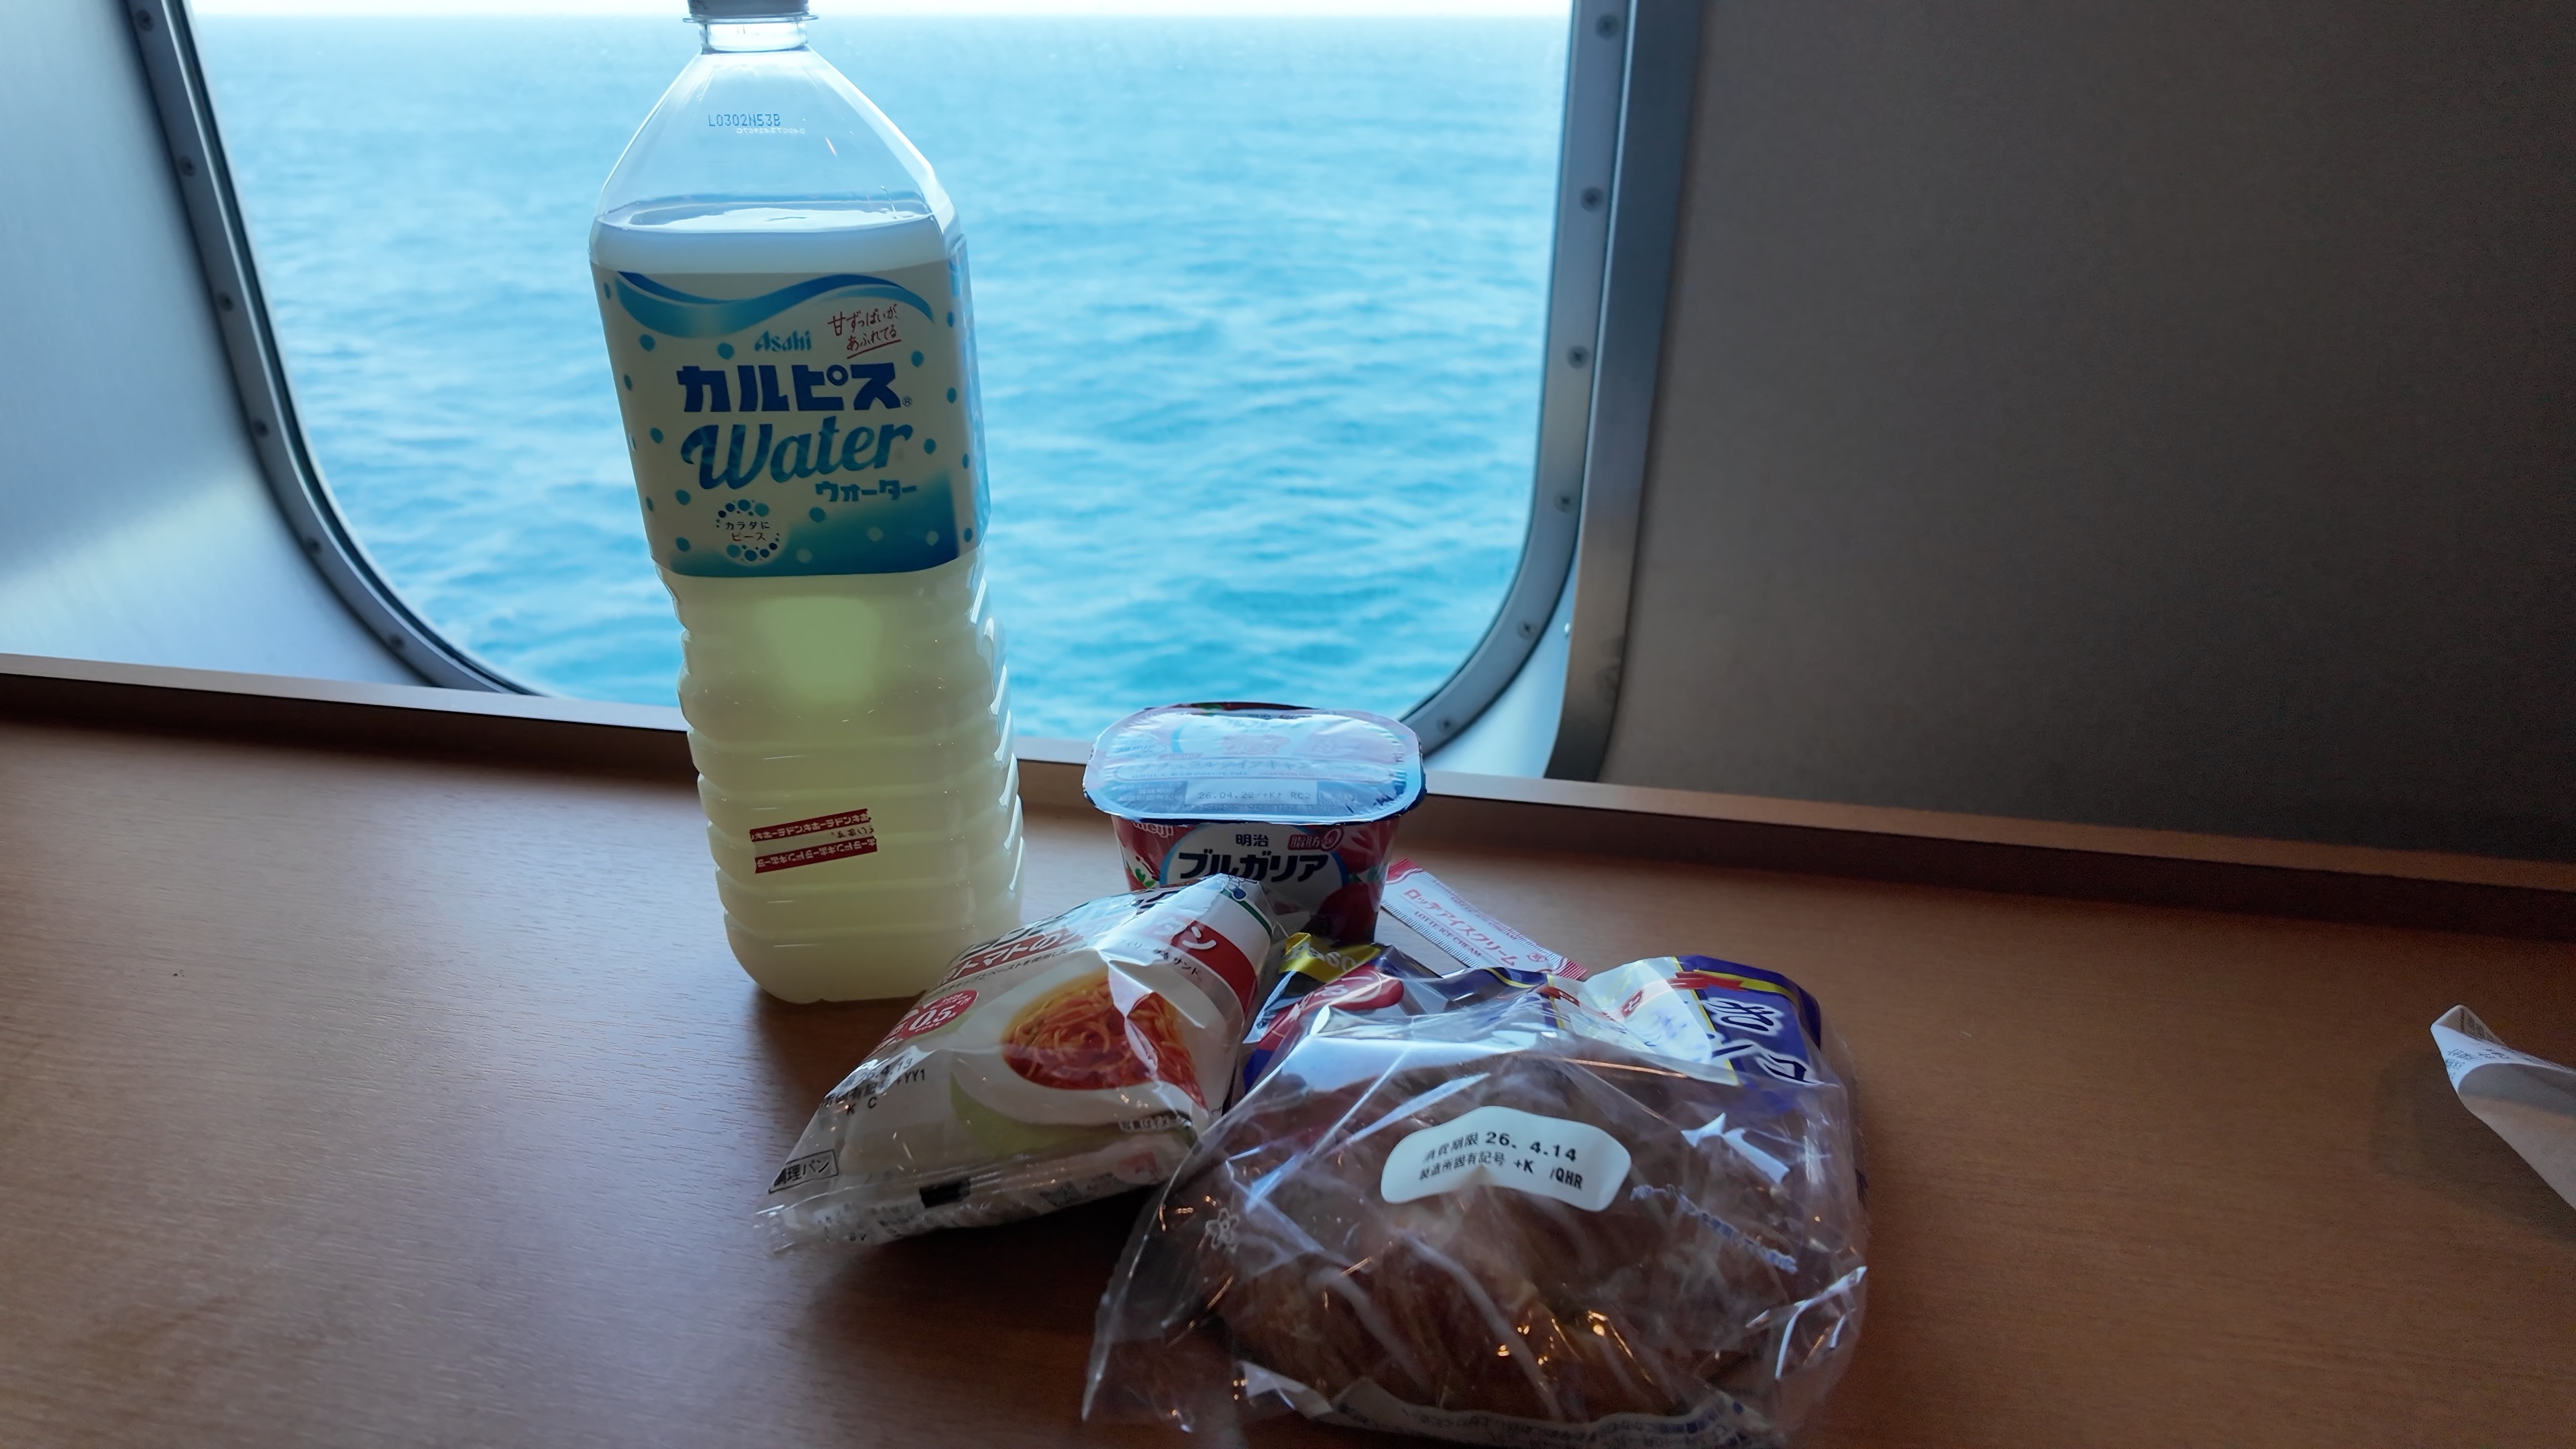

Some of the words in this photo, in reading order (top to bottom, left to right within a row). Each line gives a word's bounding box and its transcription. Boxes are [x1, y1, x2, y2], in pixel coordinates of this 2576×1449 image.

[708, 114, 781, 127] L0302N53B
[754, 330, 812, 353] Asahi
[681, 415, 913, 490] Water
[815, 480, 918, 502] ウォーター
[725, 521, 770, 530] カラダに
[1236, 834, 1269, 847] 明治
[1179, 849, 1329, 883] ブルガリア
[1415, 911, 1437, 928] LOTTE
[1440, 926, 1453, 939] ICE
[1453, 936, 1481, 957] CREAM
[867, 1097, 877, 1109] C
[1423, 1132, 1479, 1163] 消費期限
[1419, 1151, 1505, 1181] 製造所固有記号
